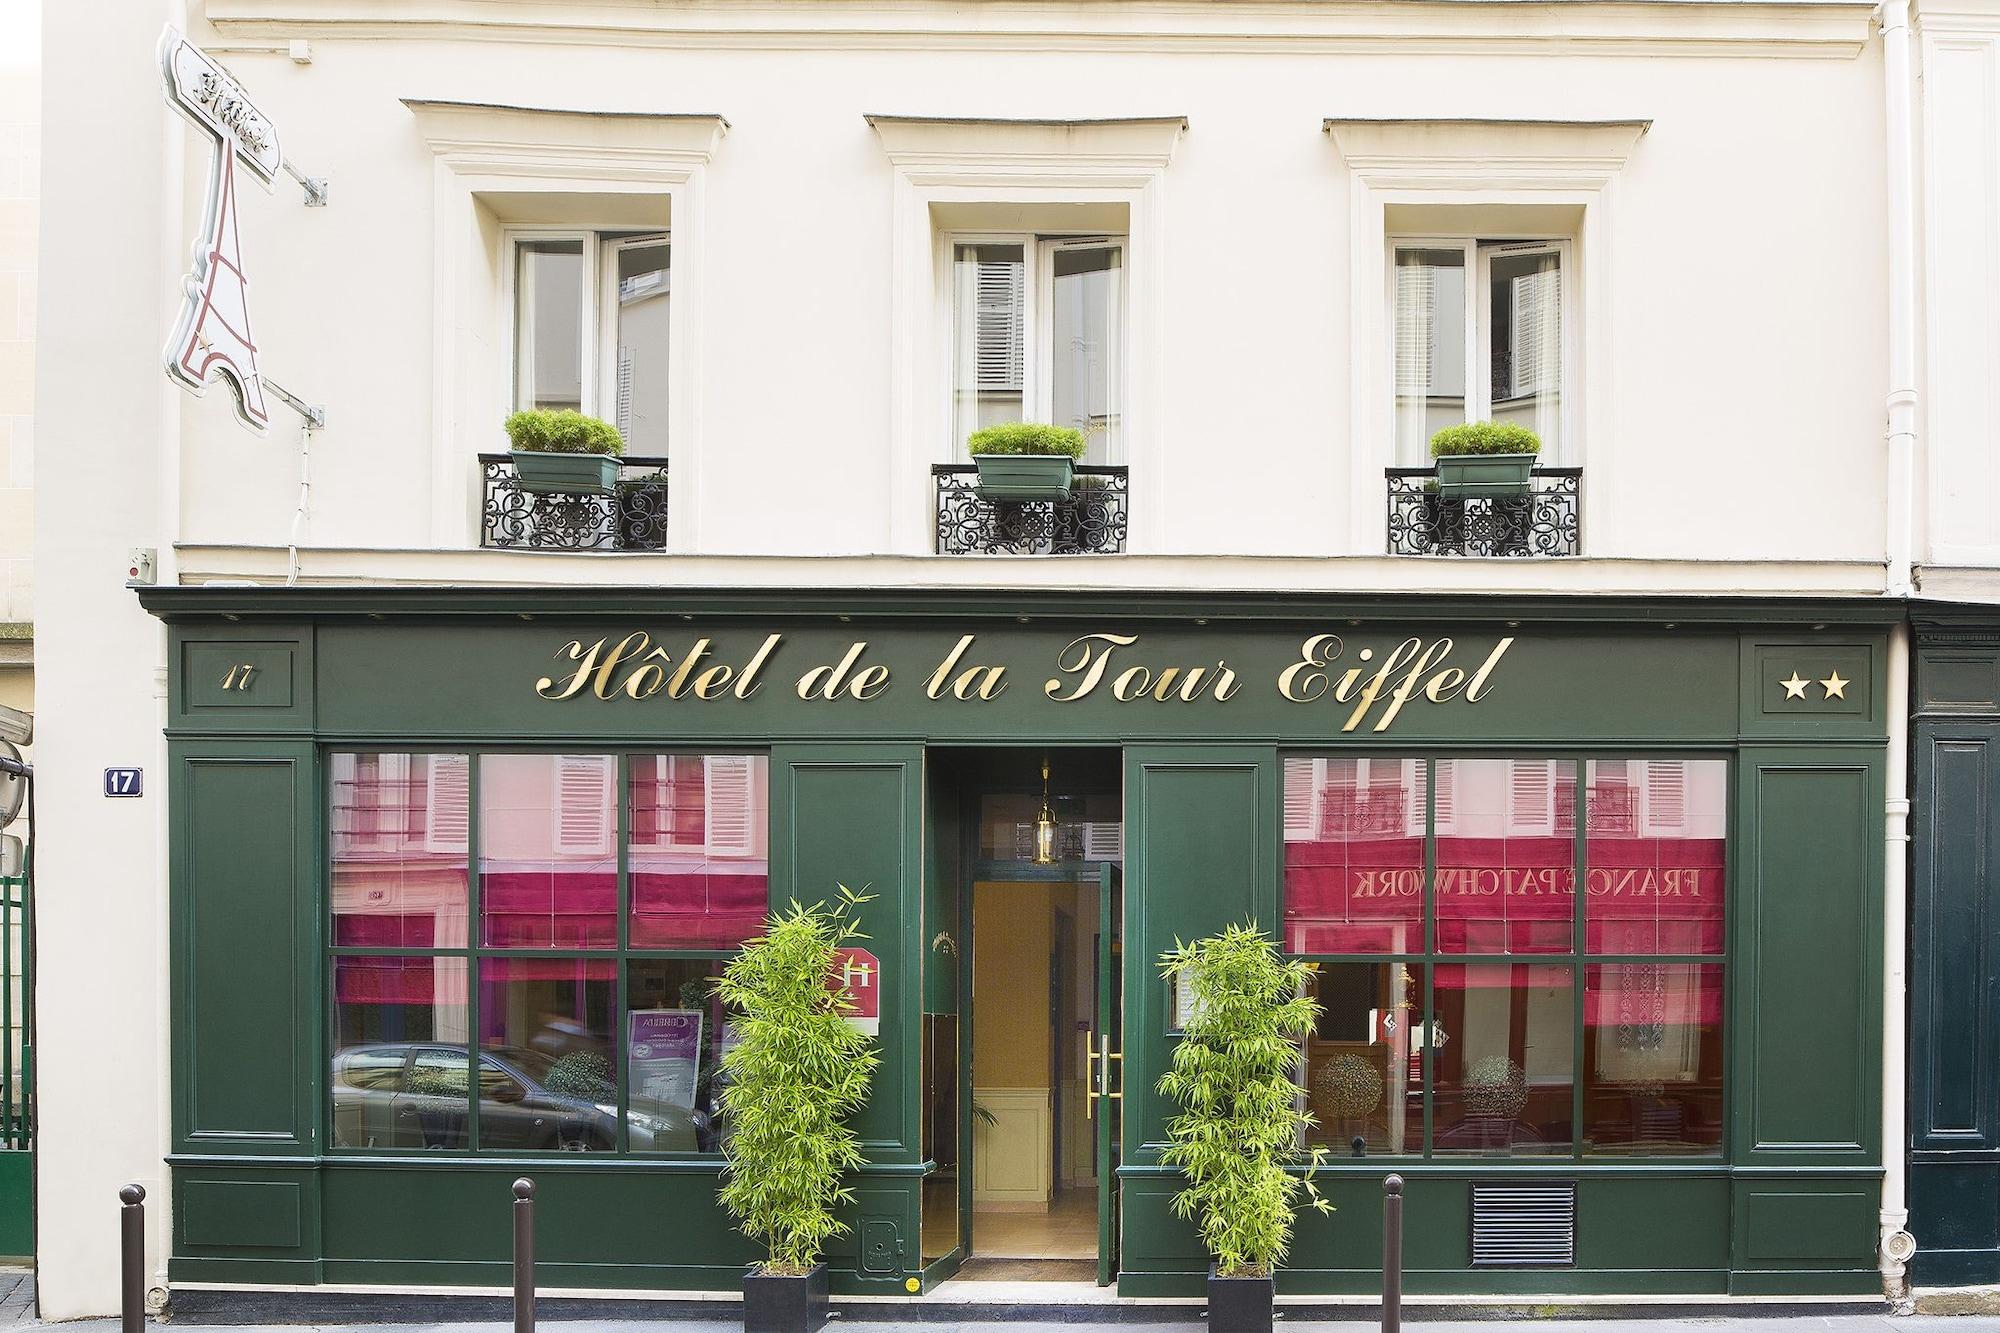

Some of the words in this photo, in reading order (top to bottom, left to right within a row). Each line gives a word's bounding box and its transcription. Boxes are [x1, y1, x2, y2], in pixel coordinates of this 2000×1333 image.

[218, 664, 255, 690] 17
[535, 630, 784, 700] Hôtel
[796, 641, 891, 700] de
[922, 634, 1009, 700] la
[1044, 633, 1243, 701] Tour
[1277, 634, 1516, 732] Eiffel
[110, 771, 135, 793] 17
[841, 962, 871, 987] H
